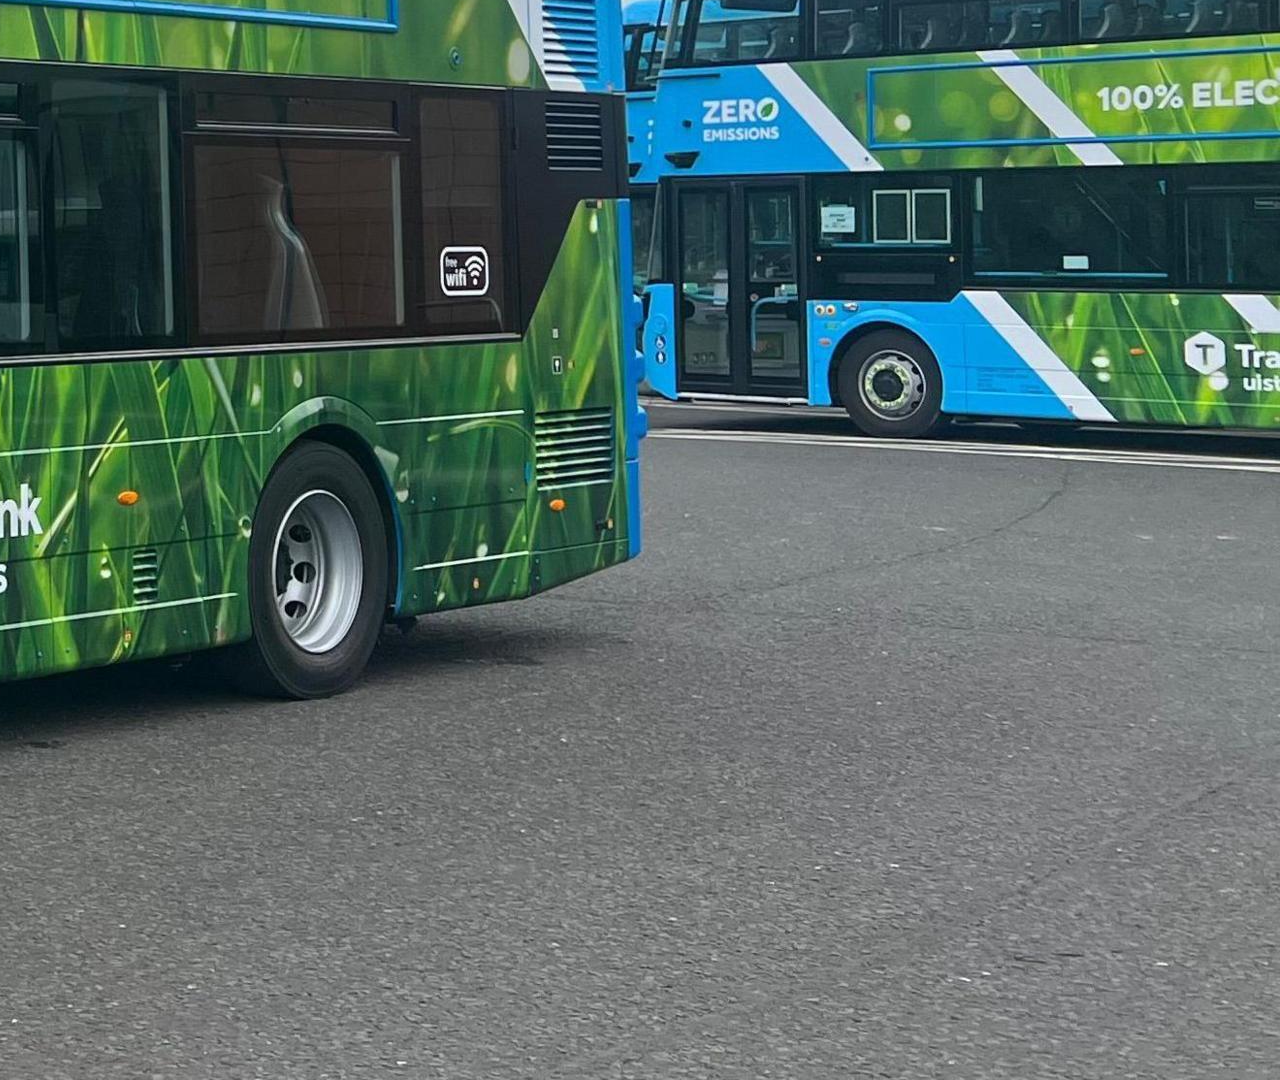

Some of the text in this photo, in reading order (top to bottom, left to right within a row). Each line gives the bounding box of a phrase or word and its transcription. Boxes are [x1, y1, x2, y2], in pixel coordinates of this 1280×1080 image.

[1096, 78, 1280, 111] 100% ELEC
[702, 97, 779, 124] ZERO
[703, 126, 780, 142] EMISSIONS
[445, 268, 467, 287] wifi
